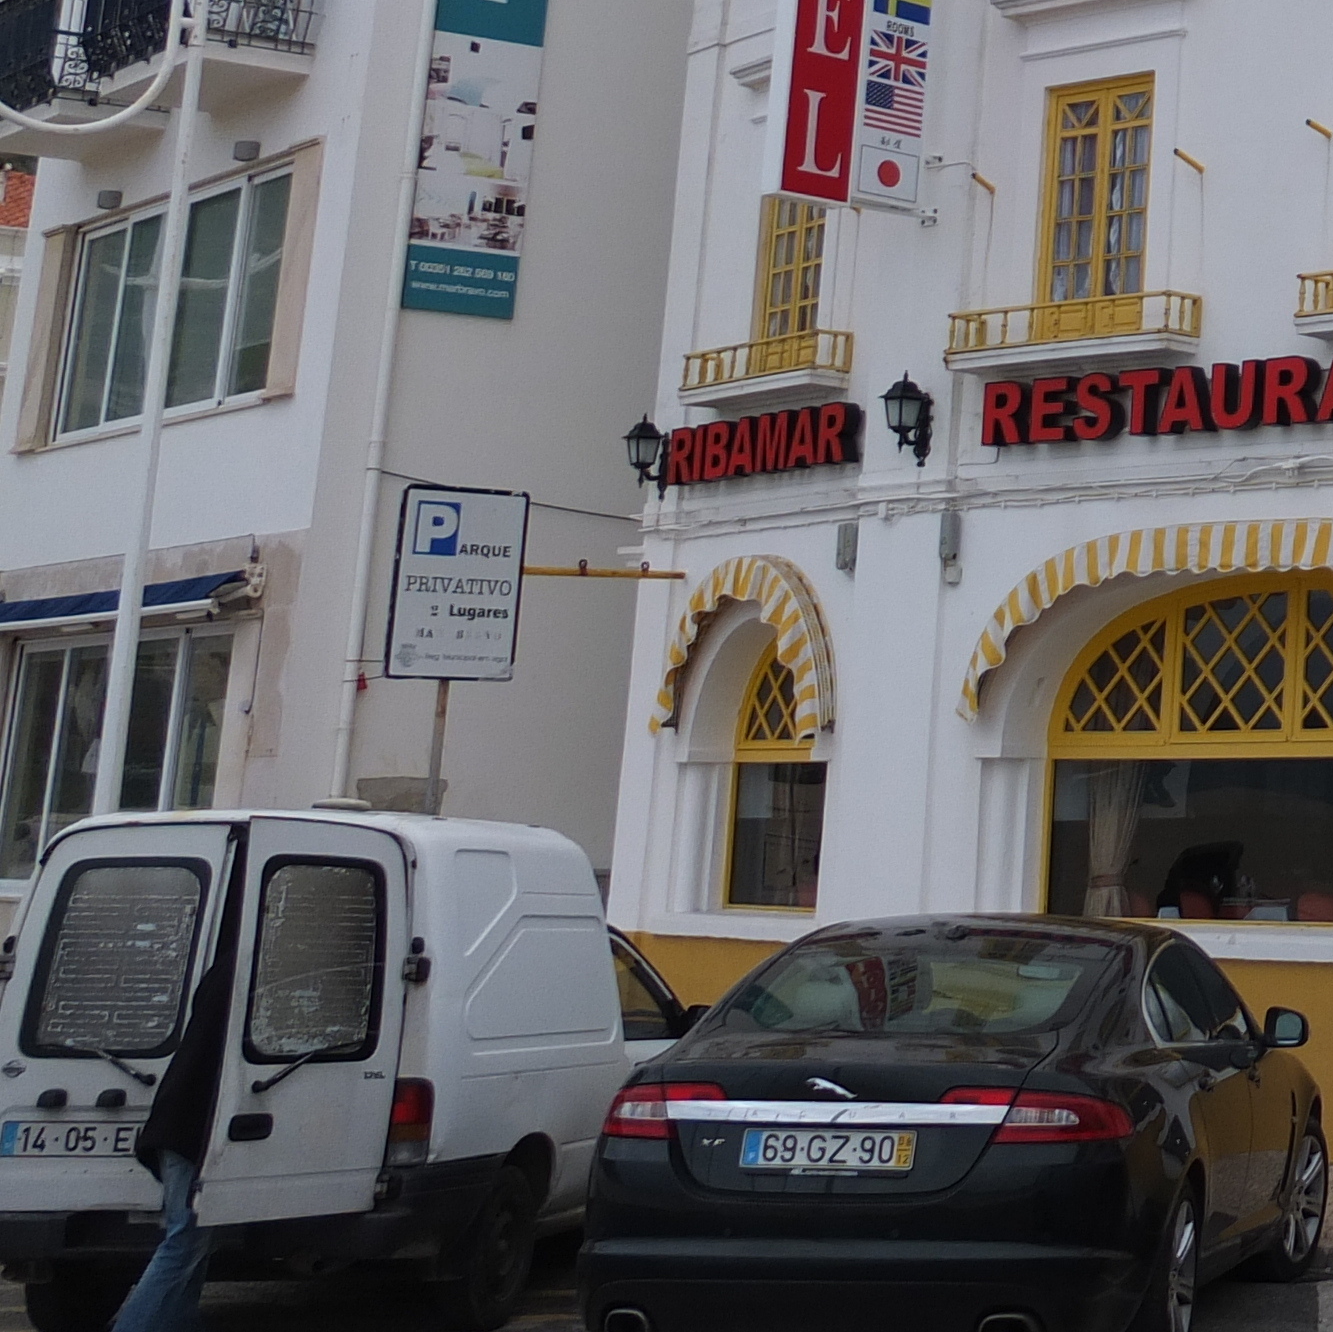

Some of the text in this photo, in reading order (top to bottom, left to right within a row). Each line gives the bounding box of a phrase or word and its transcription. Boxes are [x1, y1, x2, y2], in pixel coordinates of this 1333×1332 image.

[886, 20, 915, 38] ROOMS
[667, 401, 857, 486] RIBAMAR
[404, 574, 513, 597] PRIVATIVO
[450, 603, 509, 621] Lugares
[22, 1125, 142, 1153] 14-05-E
